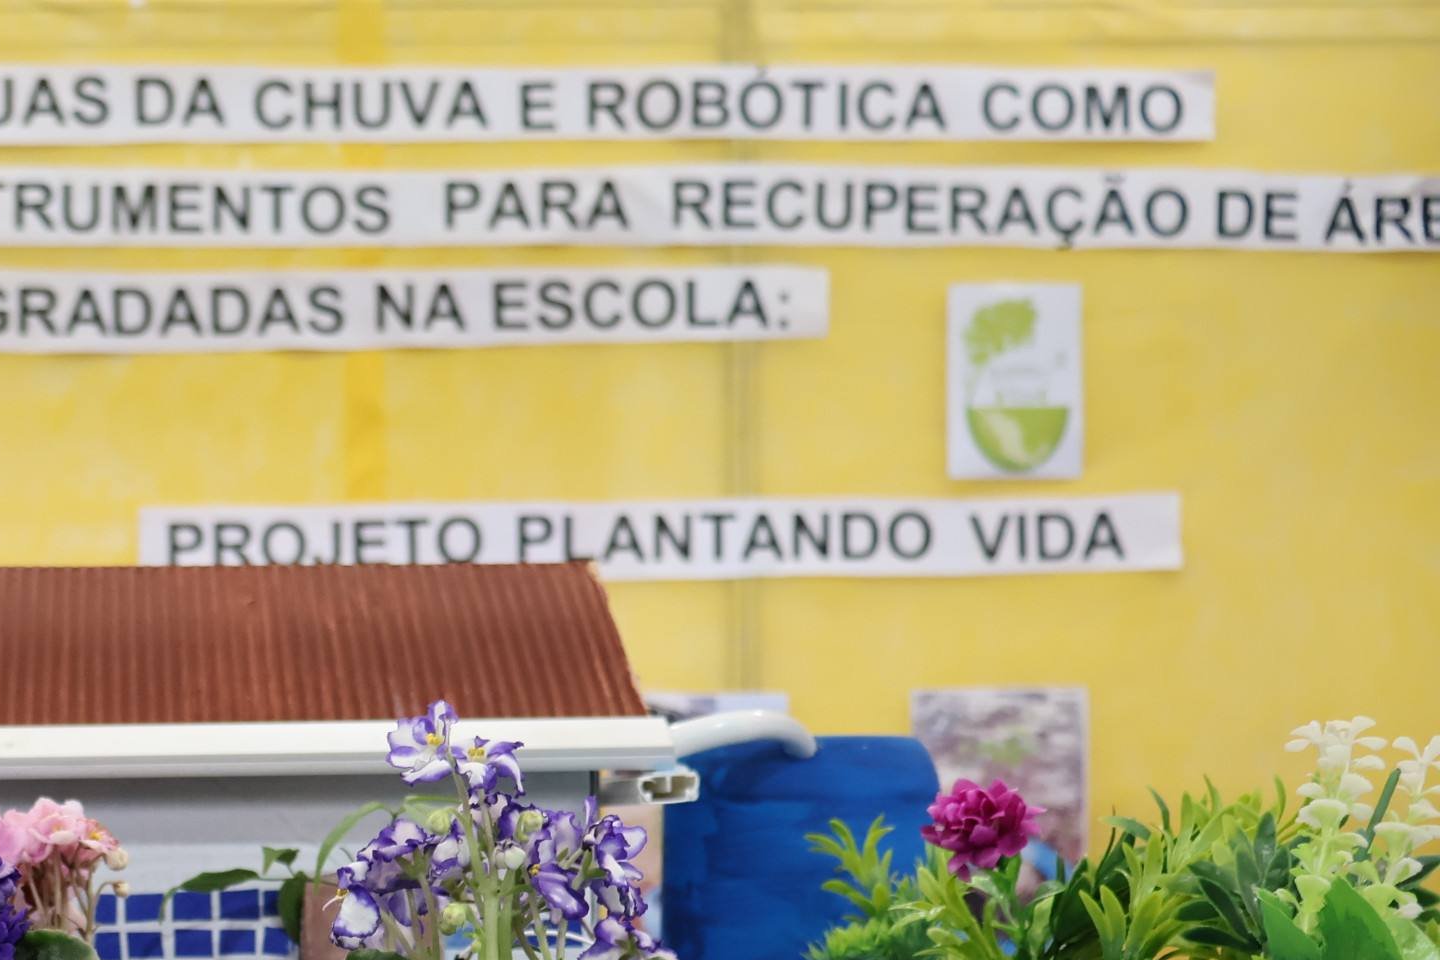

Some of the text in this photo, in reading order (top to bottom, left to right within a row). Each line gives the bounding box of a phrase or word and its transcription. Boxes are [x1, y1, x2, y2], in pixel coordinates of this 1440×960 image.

[135, 76, 225, 126] DA
[253, 80, 488, 130] CHUVA
[519, 82, 555, 131] E
[587, 66, 947, 132] ROBÓTICA
[981, 83, 1184, 133] COMO
[444, 180, 630, 231] PARA
[671, 175, 1190, 250] RECUPERAÇÃO
[1214, 187, 1298, 241] DE
[374, 281, 465, 331] NA
[492, 278, 792, 331] ESCOLA:
[166, 510, 1127, 565] PROJETO PLANTANDO VIDA
